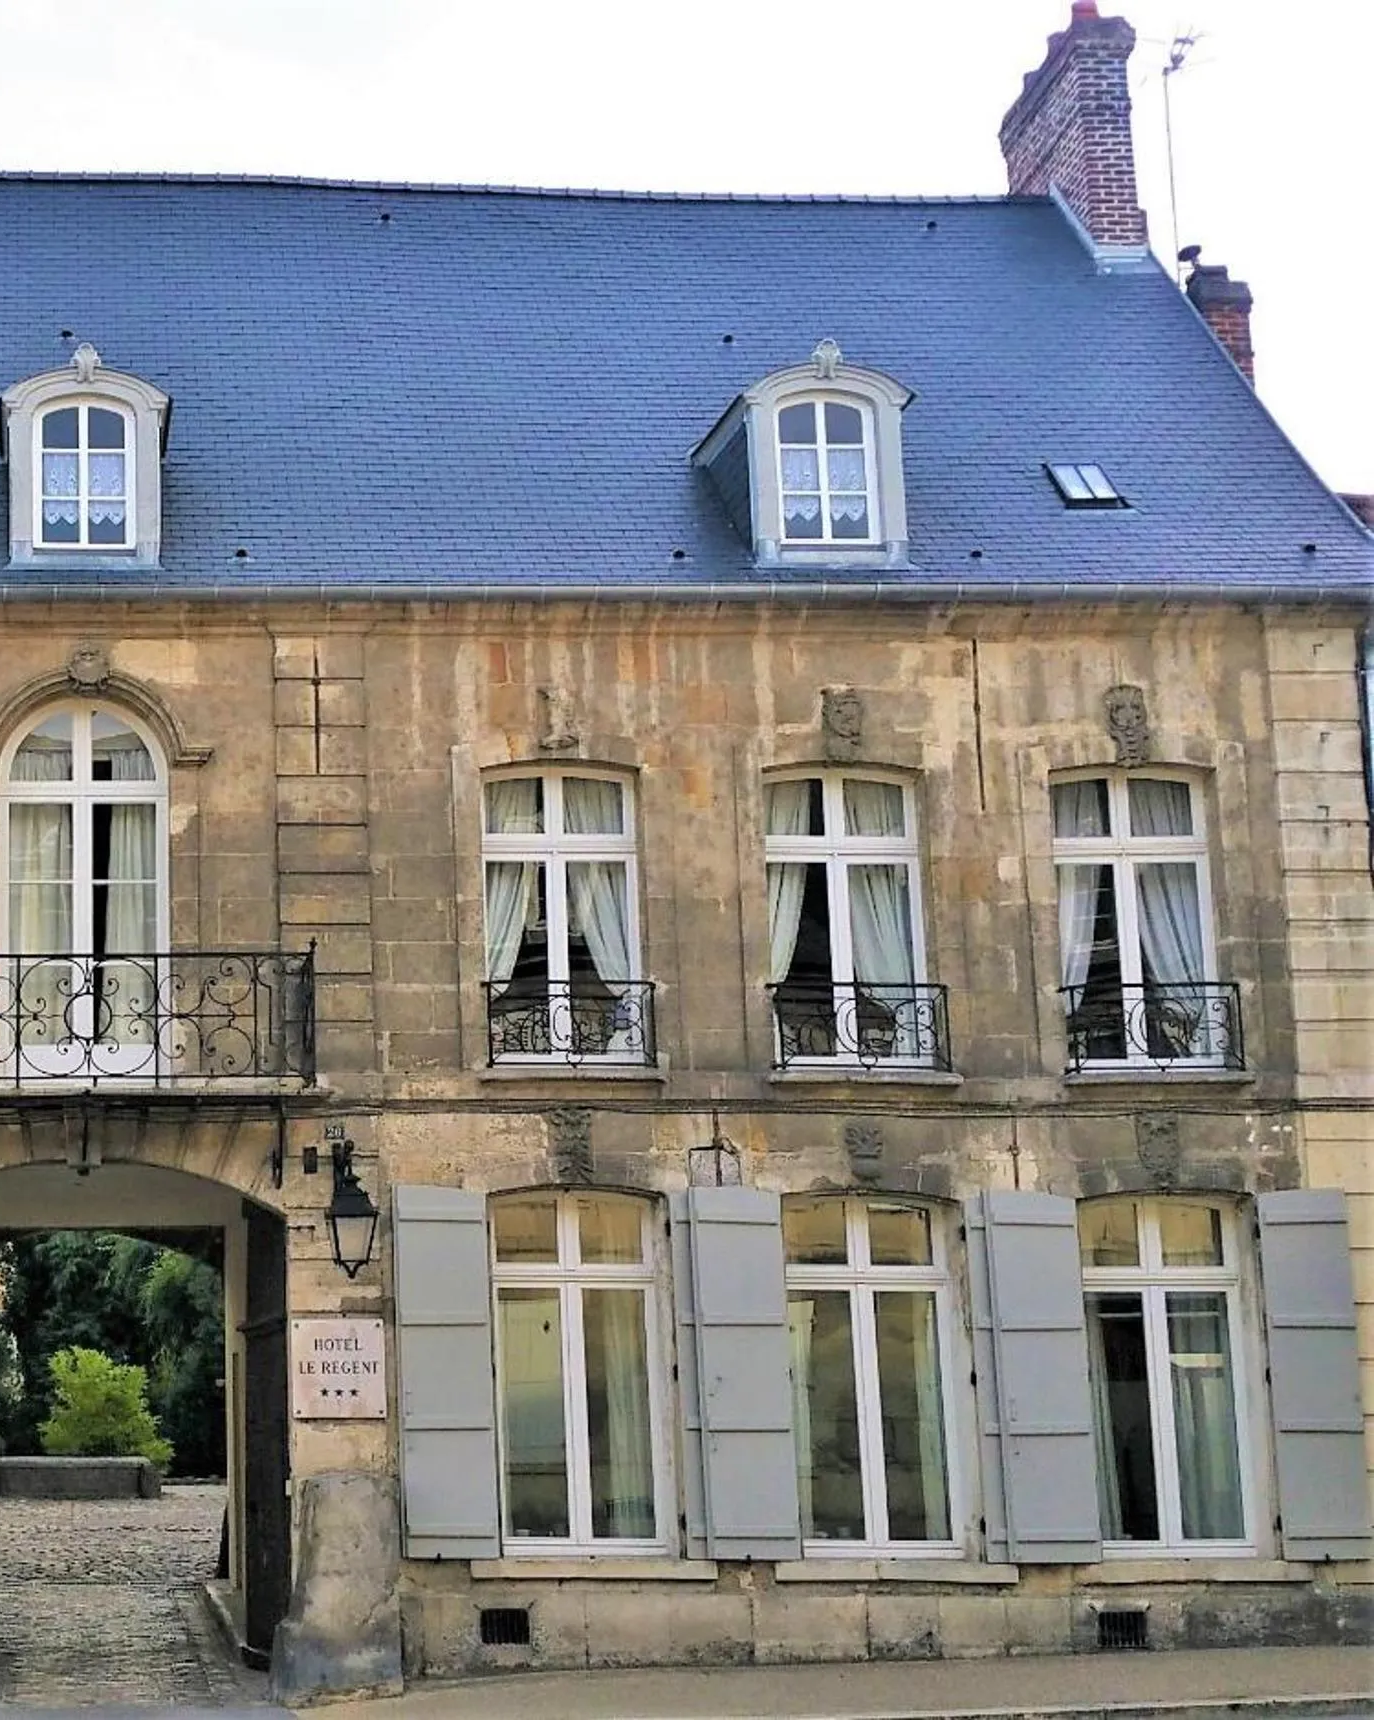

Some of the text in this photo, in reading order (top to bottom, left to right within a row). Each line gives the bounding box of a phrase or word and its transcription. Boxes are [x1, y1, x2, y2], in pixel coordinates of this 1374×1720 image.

[314, 1338, 363, 1351] HOTEL
[299, 1361, 378, 1375] LE REGENT
